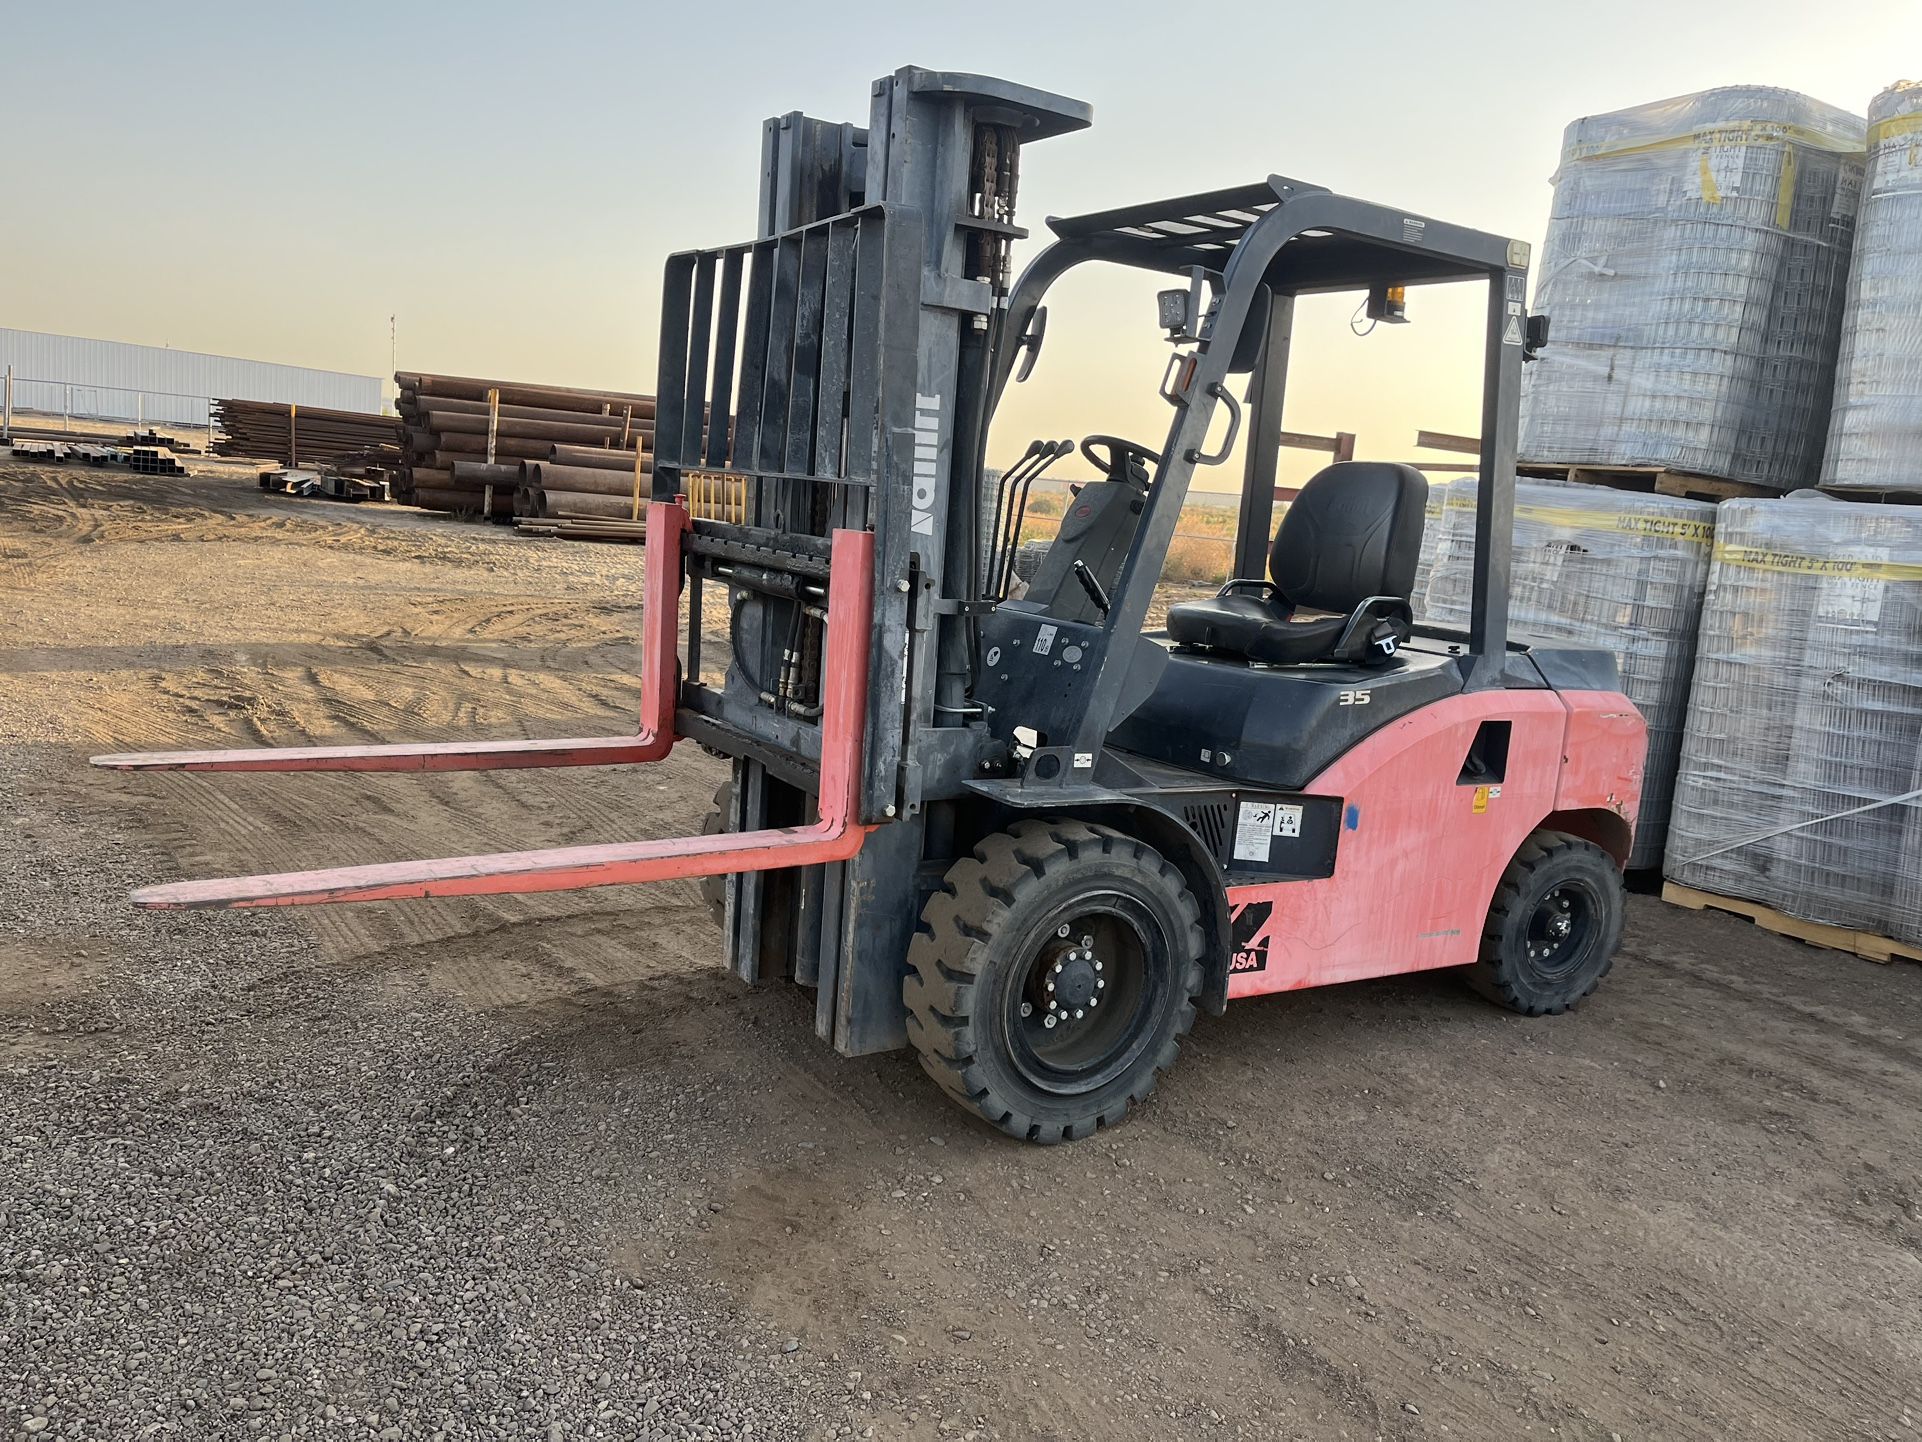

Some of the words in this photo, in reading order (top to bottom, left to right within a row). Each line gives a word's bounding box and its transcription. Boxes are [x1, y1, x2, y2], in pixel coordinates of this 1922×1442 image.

[1616, 516, 1641, 531] MAX
[1643, 518, 1678, 535] TIGHT
[1692, 524, 1701, 537] X
[1742, 550, 1768, 565] MAX
[1770, 553, 1806, 569] TIGHT
[1339, 690, 1371, 706] 35
